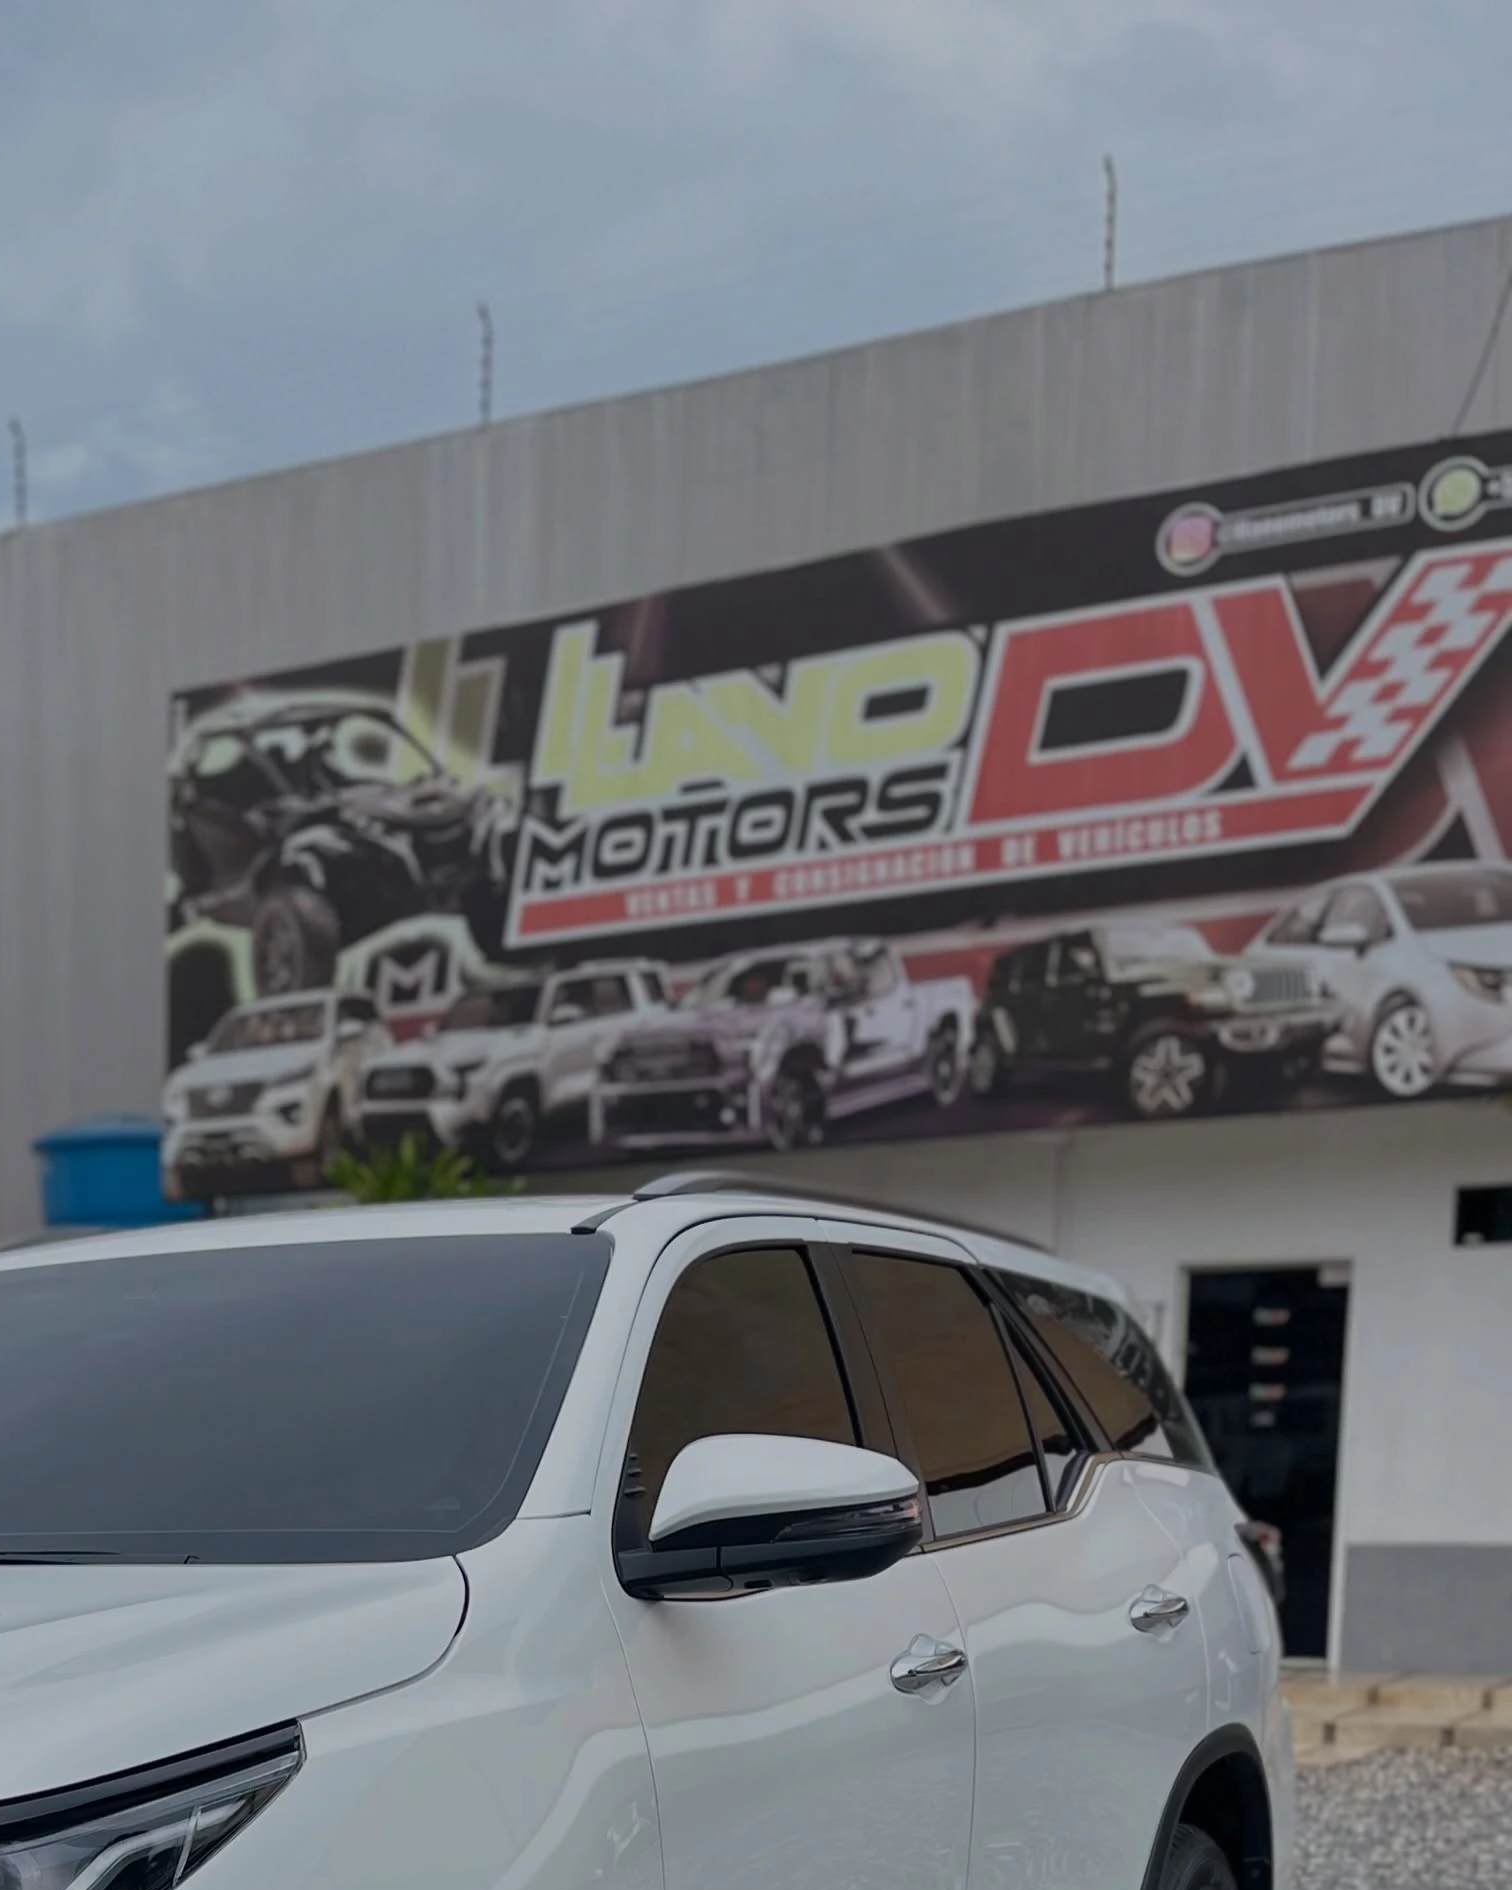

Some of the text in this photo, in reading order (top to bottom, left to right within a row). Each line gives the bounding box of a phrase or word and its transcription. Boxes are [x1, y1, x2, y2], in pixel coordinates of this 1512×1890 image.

[531, 538, 1512, 830] LLANO DV
[524, 763, 950, 893] MOTORS
[626, 877, 717, 918] VENTAS
[735, 871, 752, 901] Y
[1001, 834, 1038, 866] DE
